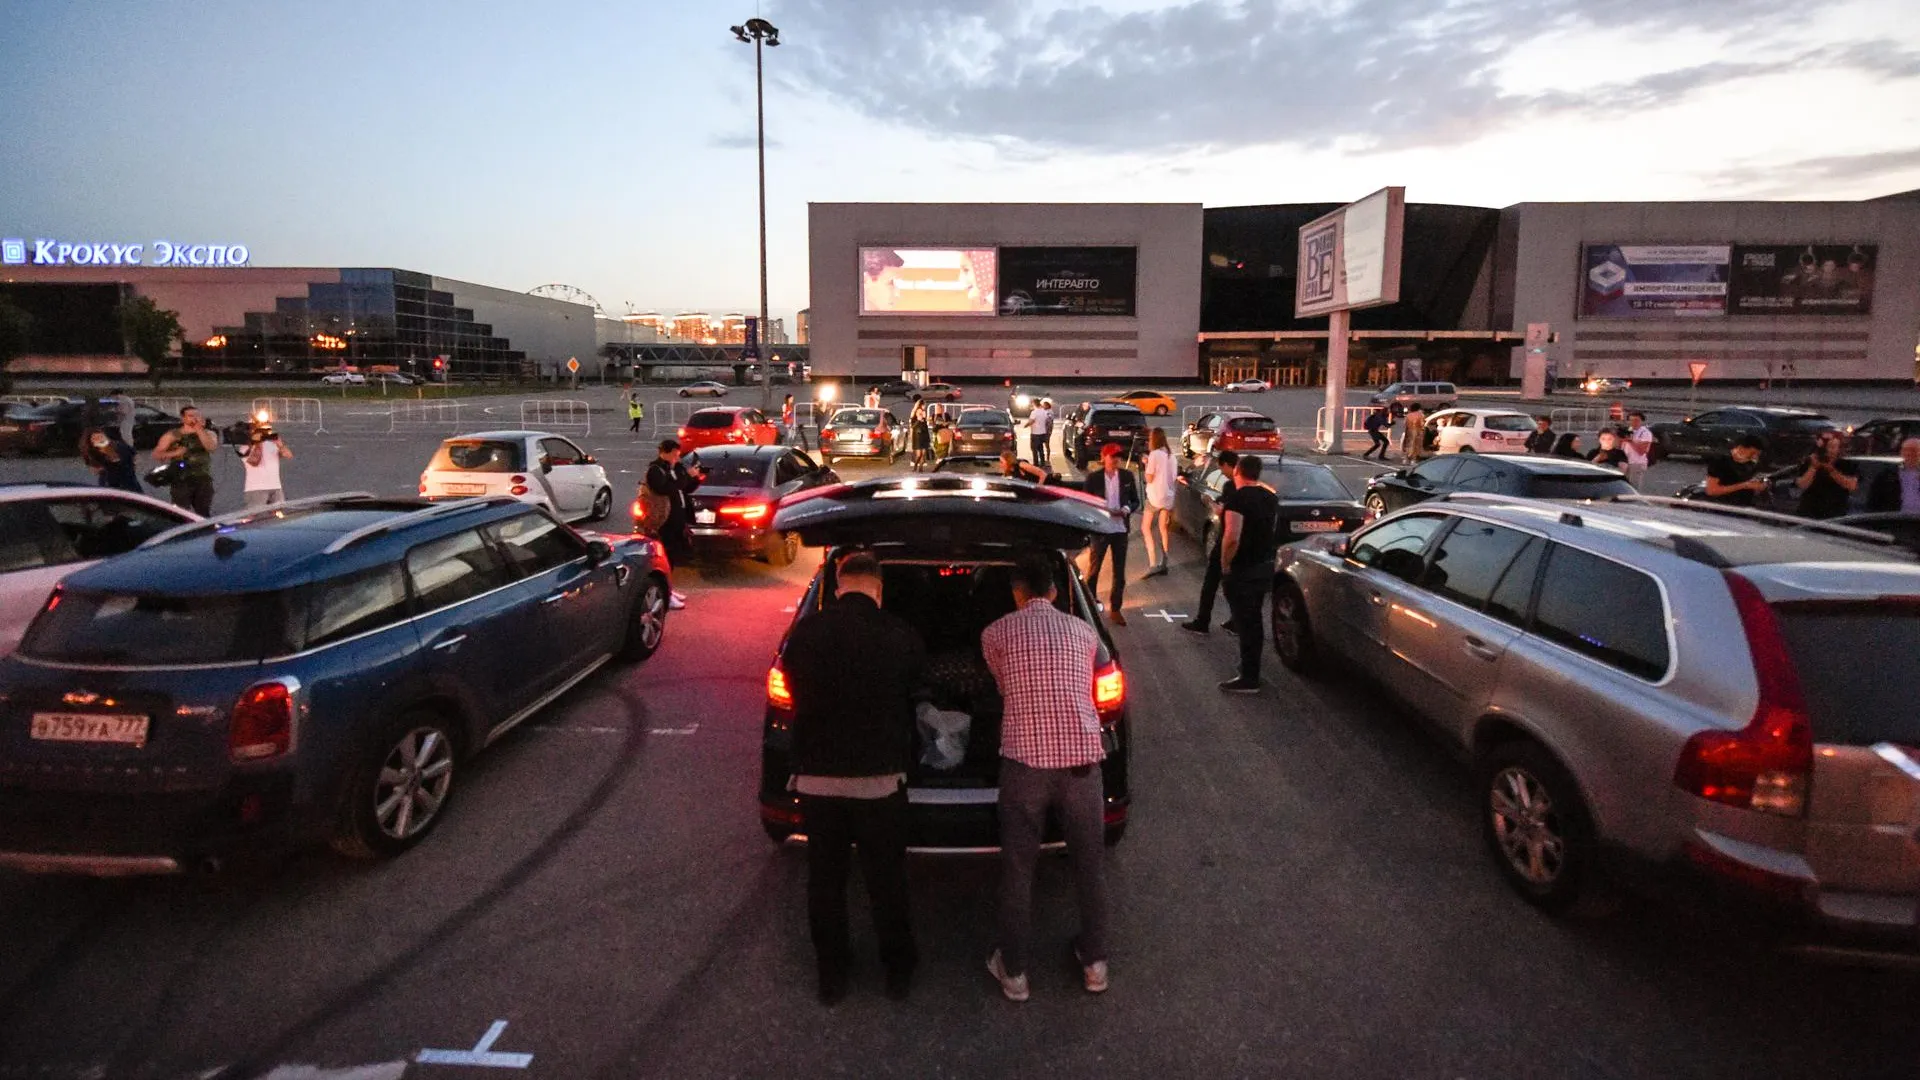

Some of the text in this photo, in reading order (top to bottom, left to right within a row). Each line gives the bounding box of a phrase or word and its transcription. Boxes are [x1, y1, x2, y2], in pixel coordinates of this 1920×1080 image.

[34, 240, 249, 265] КРОКУС ЭКСПО
[1036, 279, 1100, 289] ИНТЕРАВТО
